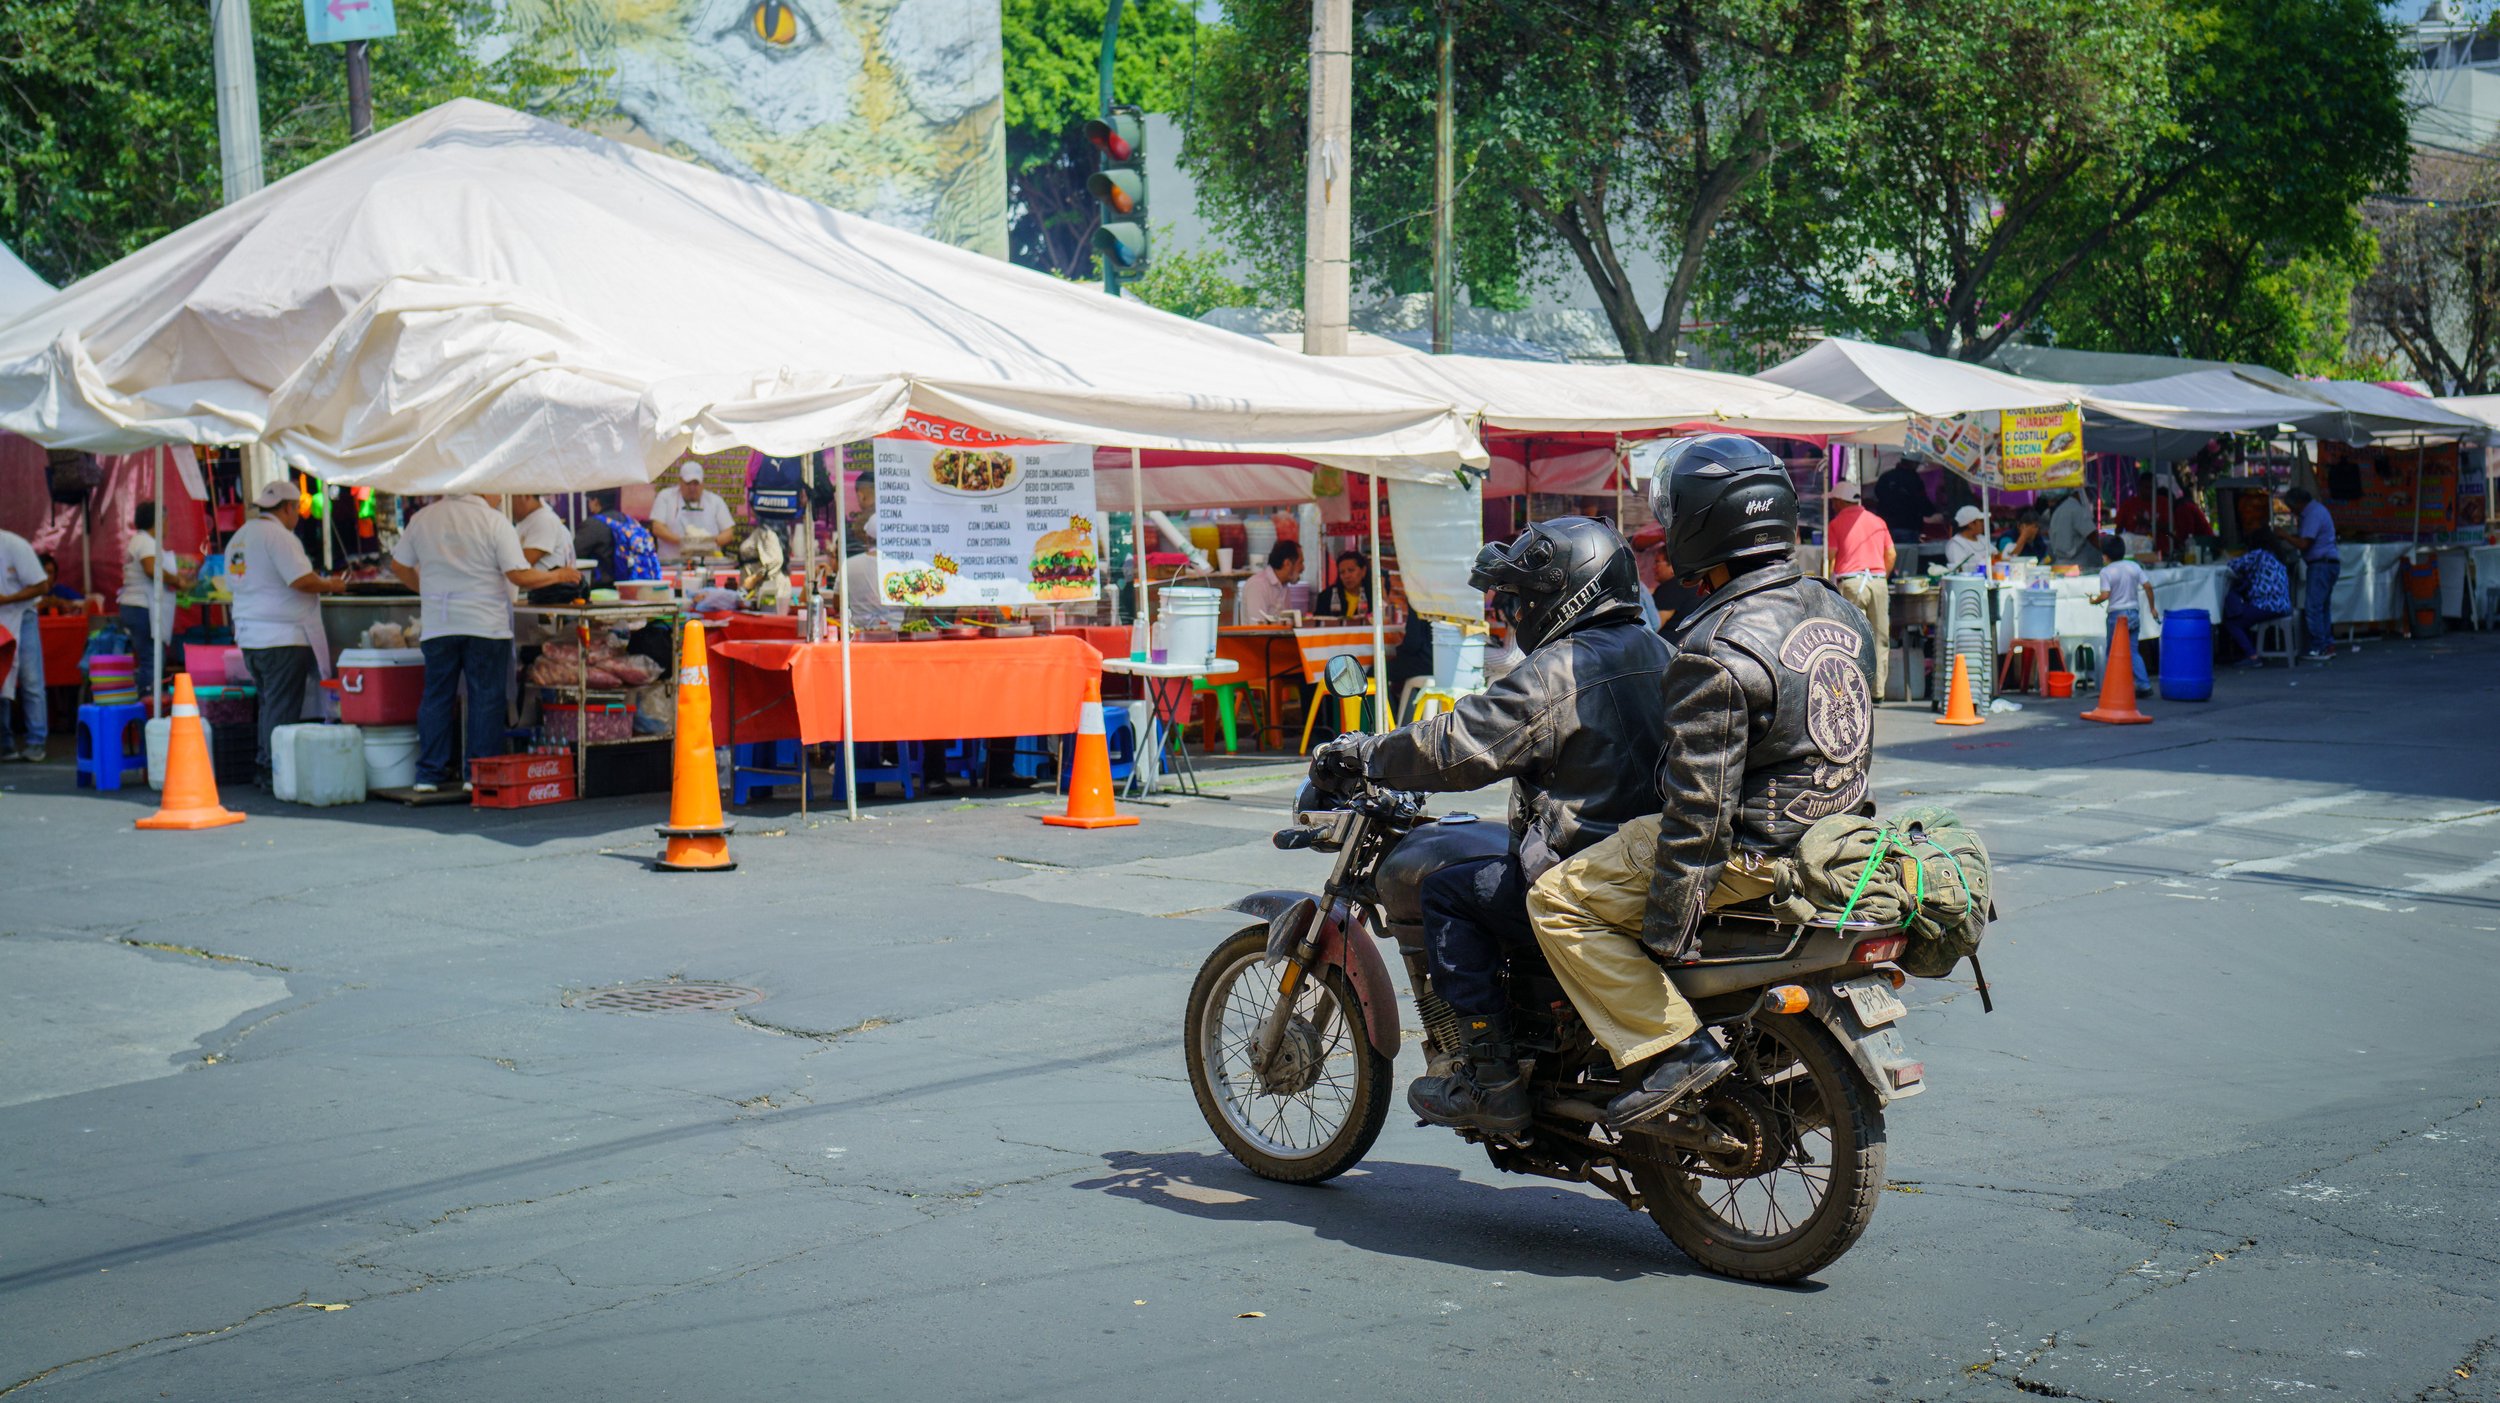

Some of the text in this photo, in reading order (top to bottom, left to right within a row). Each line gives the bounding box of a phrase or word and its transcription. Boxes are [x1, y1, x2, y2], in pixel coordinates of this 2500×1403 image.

[2016, 415, 2063, 429] HUARACHES
[949, 426, 974, 442] EL
[2013, 430, 2048, 442] COSTILLA
[2013, 444, 2042, 455] CECINA
[1025, 456, 1040, 465] DEDO
[1025, 482, 1039, 492] DEDO
[1025, 495, 1057, 505] DEDO TRIPLE
[980, 504, 998, 514] TRIPLE
[1745, 497, 1774, 516] HALF
[880, 509, 903, 519] CECINA
[931, 524, 949, 534] QUESO
[968, 521, 1011, 531] CON LONGANIZA
[1026, 522, 1048, 531] VOLCAN
[966, 537, 1011, 547] CON CHISTORRA
[961, 556, 1018, 566] CHORIZO ARGENTINO
[973, 571, 1005, 581] CHISTORRA
[980, 587, 999, 597] QUESO
